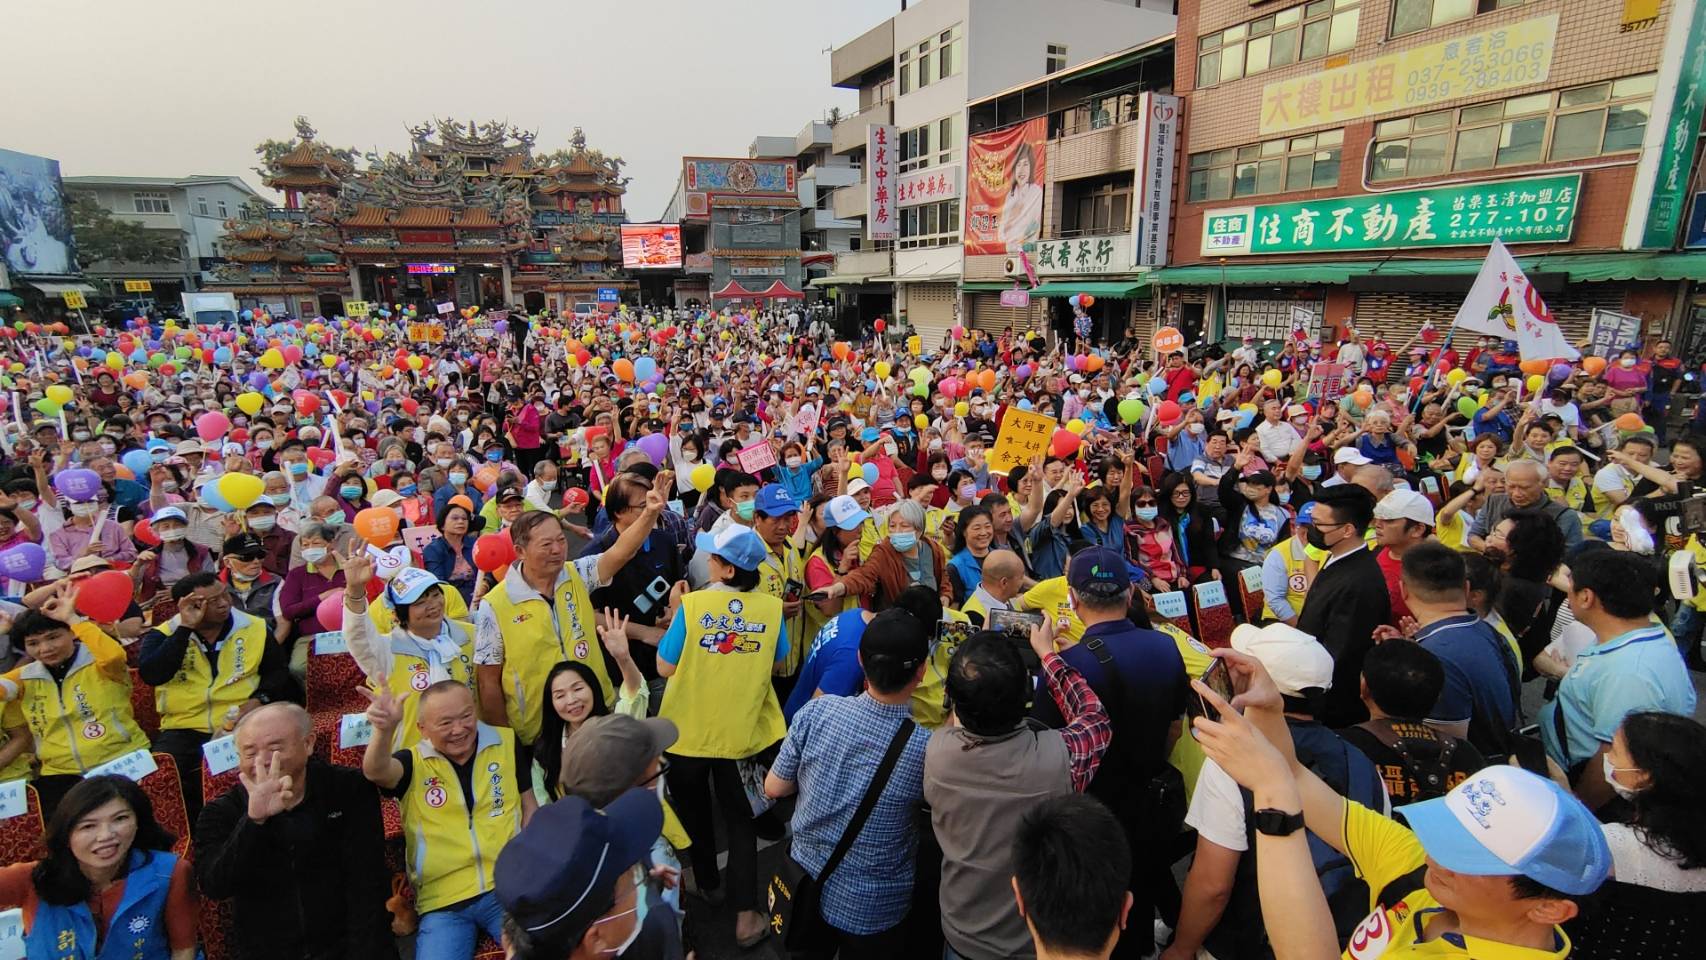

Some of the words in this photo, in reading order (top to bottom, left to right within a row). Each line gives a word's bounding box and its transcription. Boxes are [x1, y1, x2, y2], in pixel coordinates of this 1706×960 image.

[1443, 31, 1508, 61] 意者洽
[1407, 41, 1544, 87] 037-253066
[1265, 61, 1397, 126] 大樓出租
[1405, 61, 1541, 103] 0939-288403
[875, 127, 889, 224] 生光中藥房
[898, 174, 948, 201] 生光中藥房
[1453, 187, 1574, 211] 苗栗玉清加盟店
[1213, 217, 1243, 233] 住商
[1260, 197, 1437, 246] 住商不動產
[1450, 206, 1569, 228] 277-107
[1213, 235, 1241, 246] 不動產
[1038, 239, 1114, 269] 飄香茶行
[1011, 417, 1047, 435] 大同里
[1294, 576, 1305, 591] 3
[578, 642, 588, 658] 3
[415, 672, 429, 690] 3
[88, 724, 102, 738] 3
[430, 788, 443, 806] 3
[1353, 912, 1383, 952] 3
